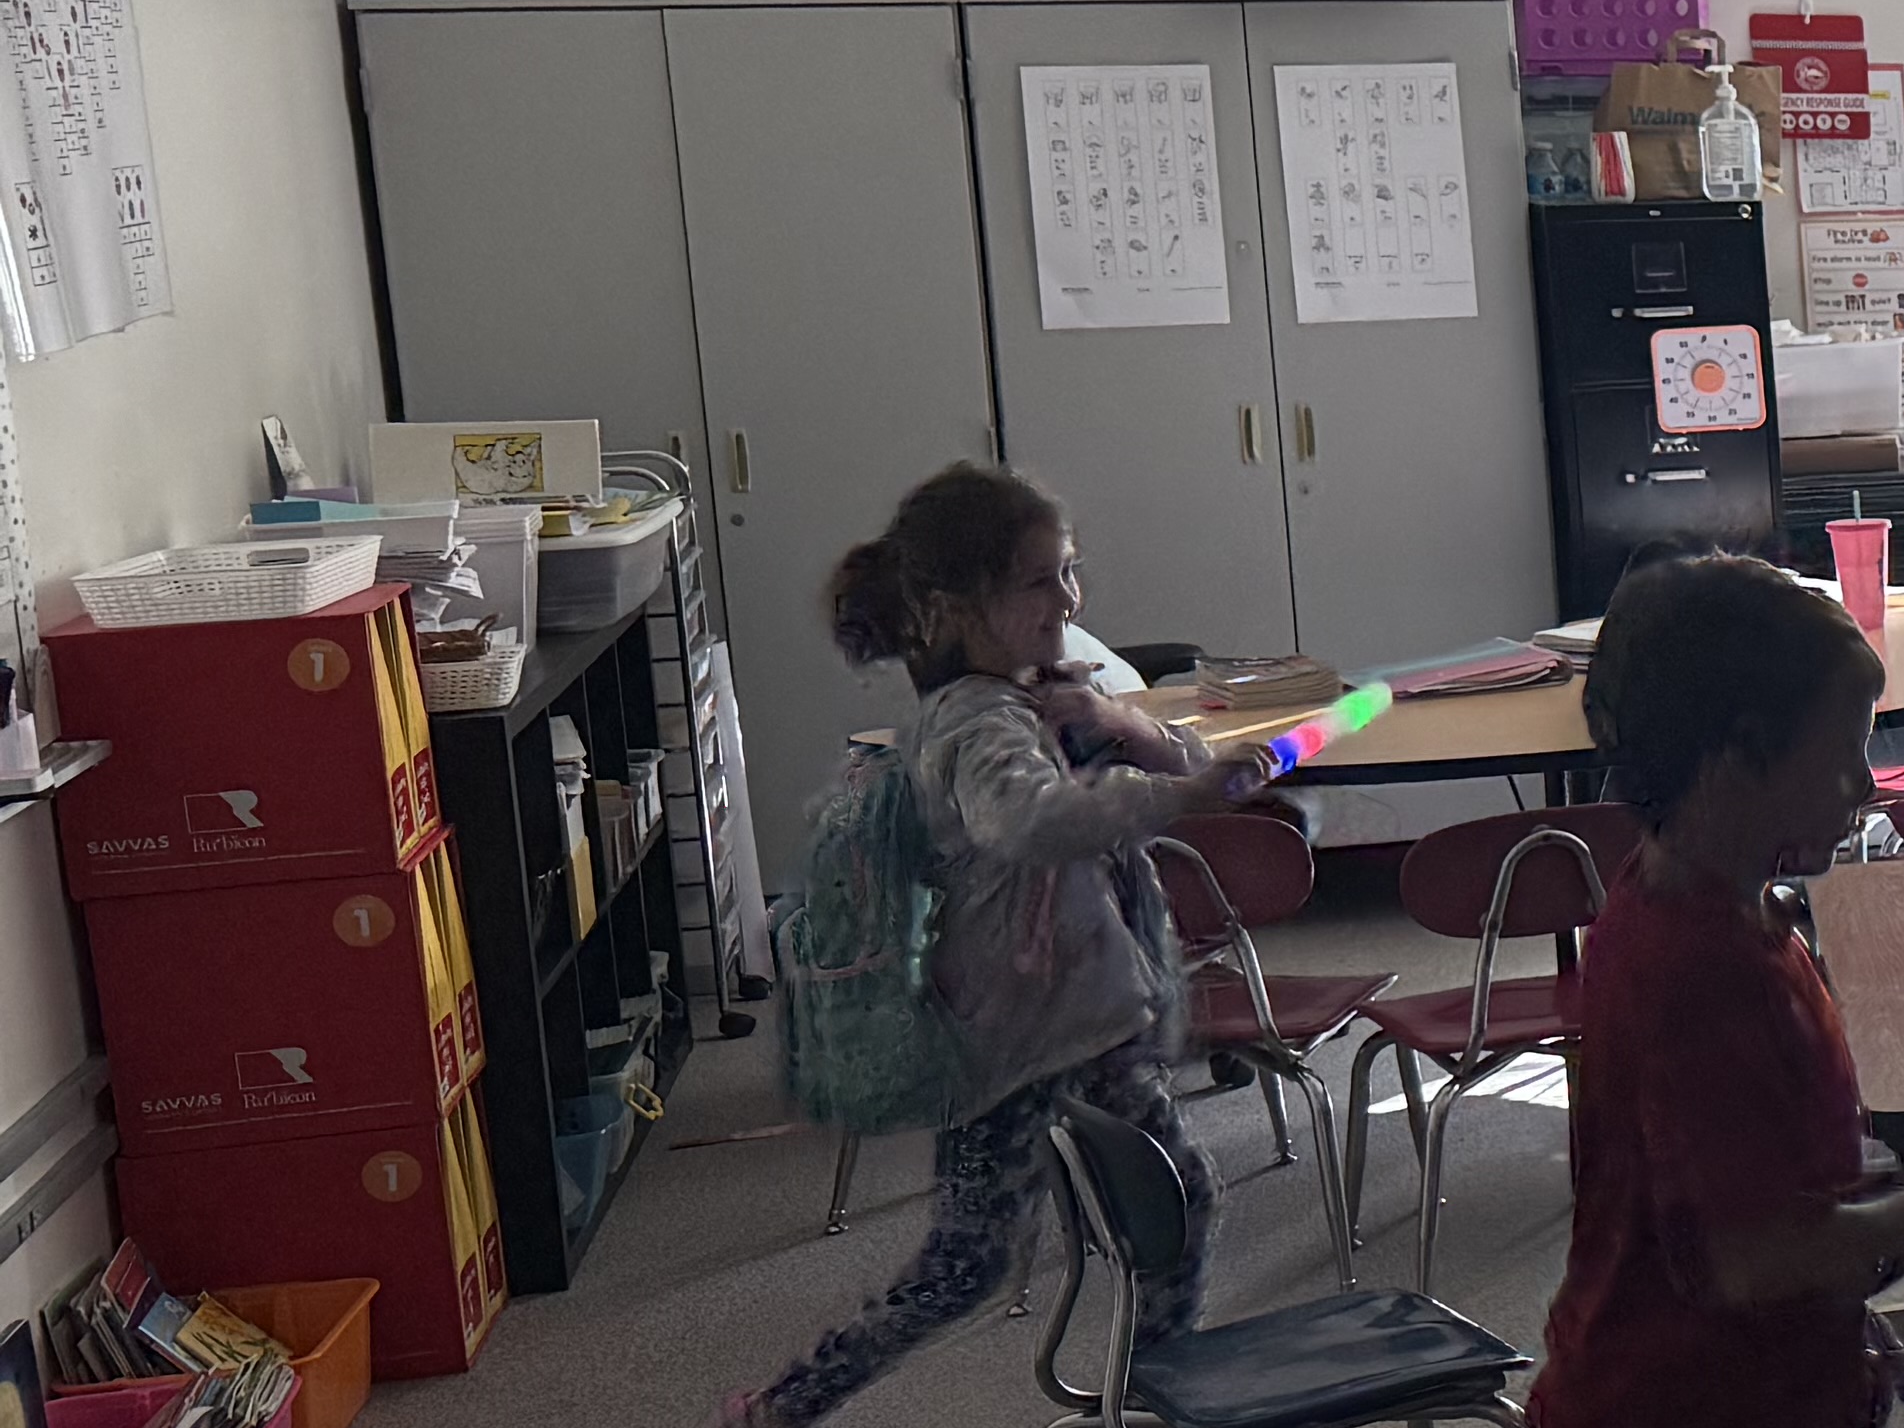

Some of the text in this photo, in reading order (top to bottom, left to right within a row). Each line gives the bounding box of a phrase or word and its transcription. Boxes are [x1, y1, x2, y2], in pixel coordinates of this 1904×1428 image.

[1805, 96, 1842, 109] RESPONSE
[1843, 96, 1865, 109] GUIDE
[1629, 105, 1710, 126] Walm
[308, 651, 325, 683] 1
[86, 835, 170, 854] SAVVAS
[353, 907, 371, 938] 1
[141, 1092, 222, 1114] SAVVAS
[382, 1163, 398, 1193] 1
